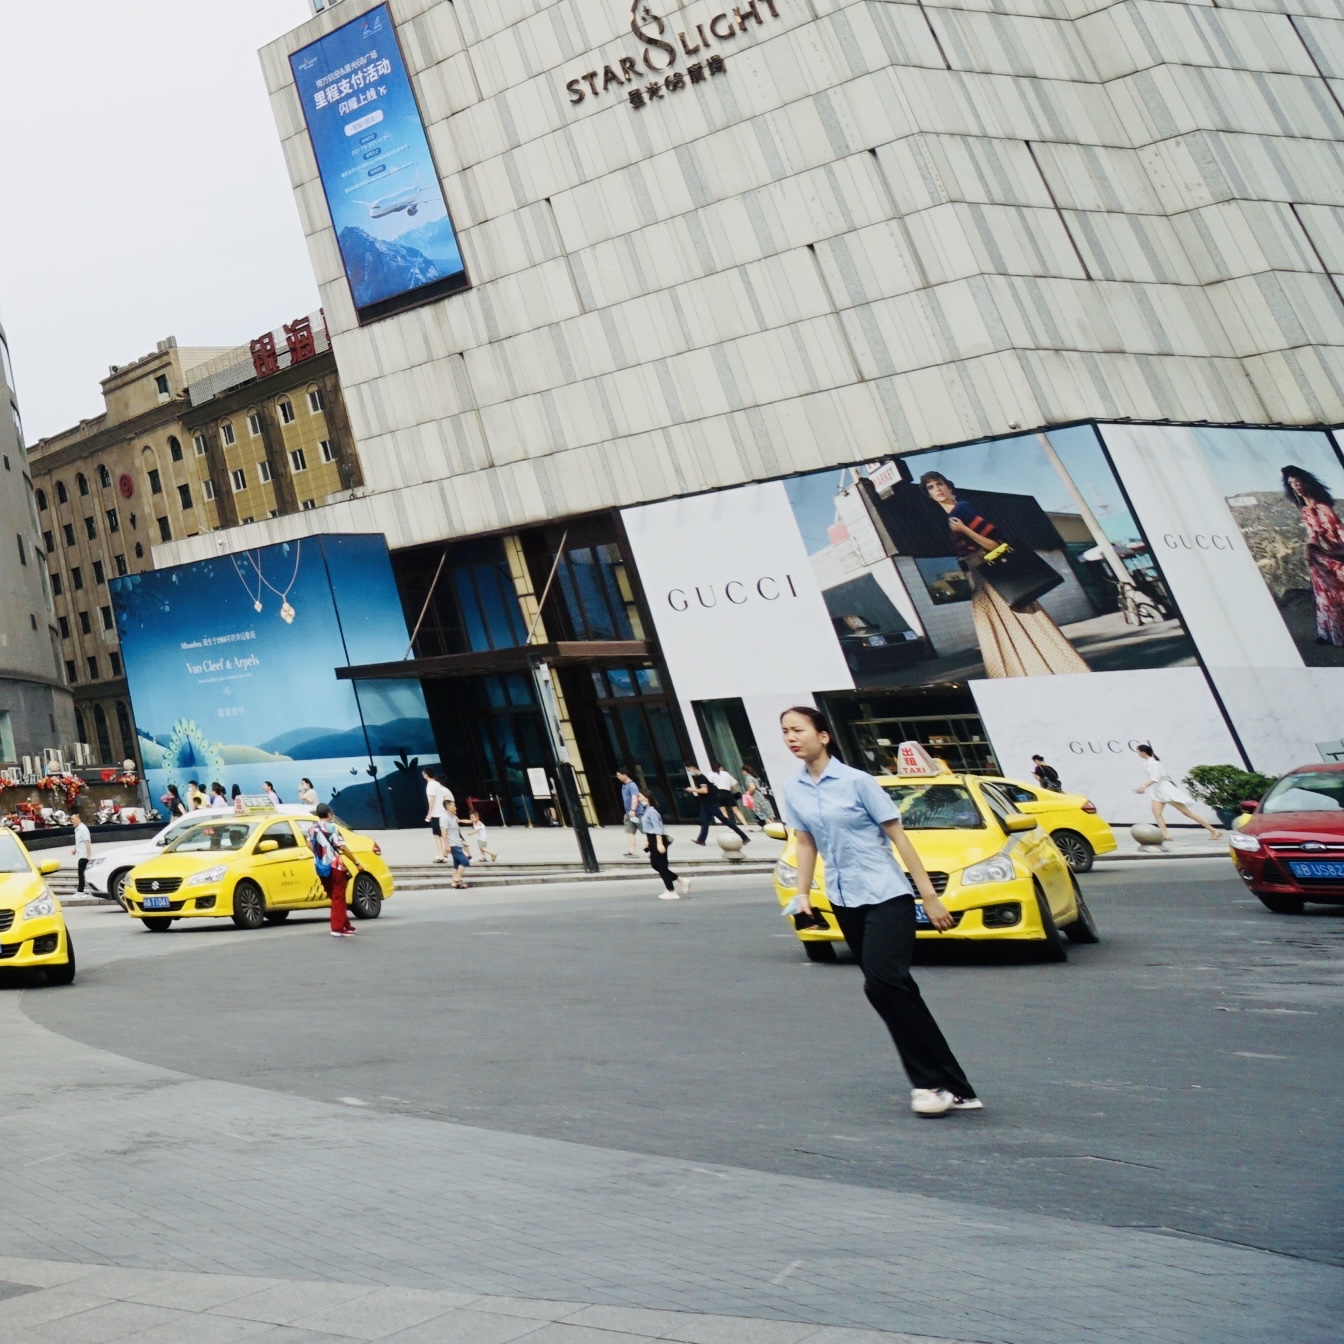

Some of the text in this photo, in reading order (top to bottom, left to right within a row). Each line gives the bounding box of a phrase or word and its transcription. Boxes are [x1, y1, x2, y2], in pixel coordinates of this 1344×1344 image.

[314, 58, 391, 109] 里程支付活动
[566, 56, 644, 104] STAR
[339, 87, 377, 116] 闪耀上线
[250, 308, 332, 379] 银海
[1164, 533, 1236, 551] GUCCI
[667, 574, 799, 613] GUCCI
[186, 653, 260, 674] Van Cleef & Arpels
[901, 747, 918, 766] 出租
